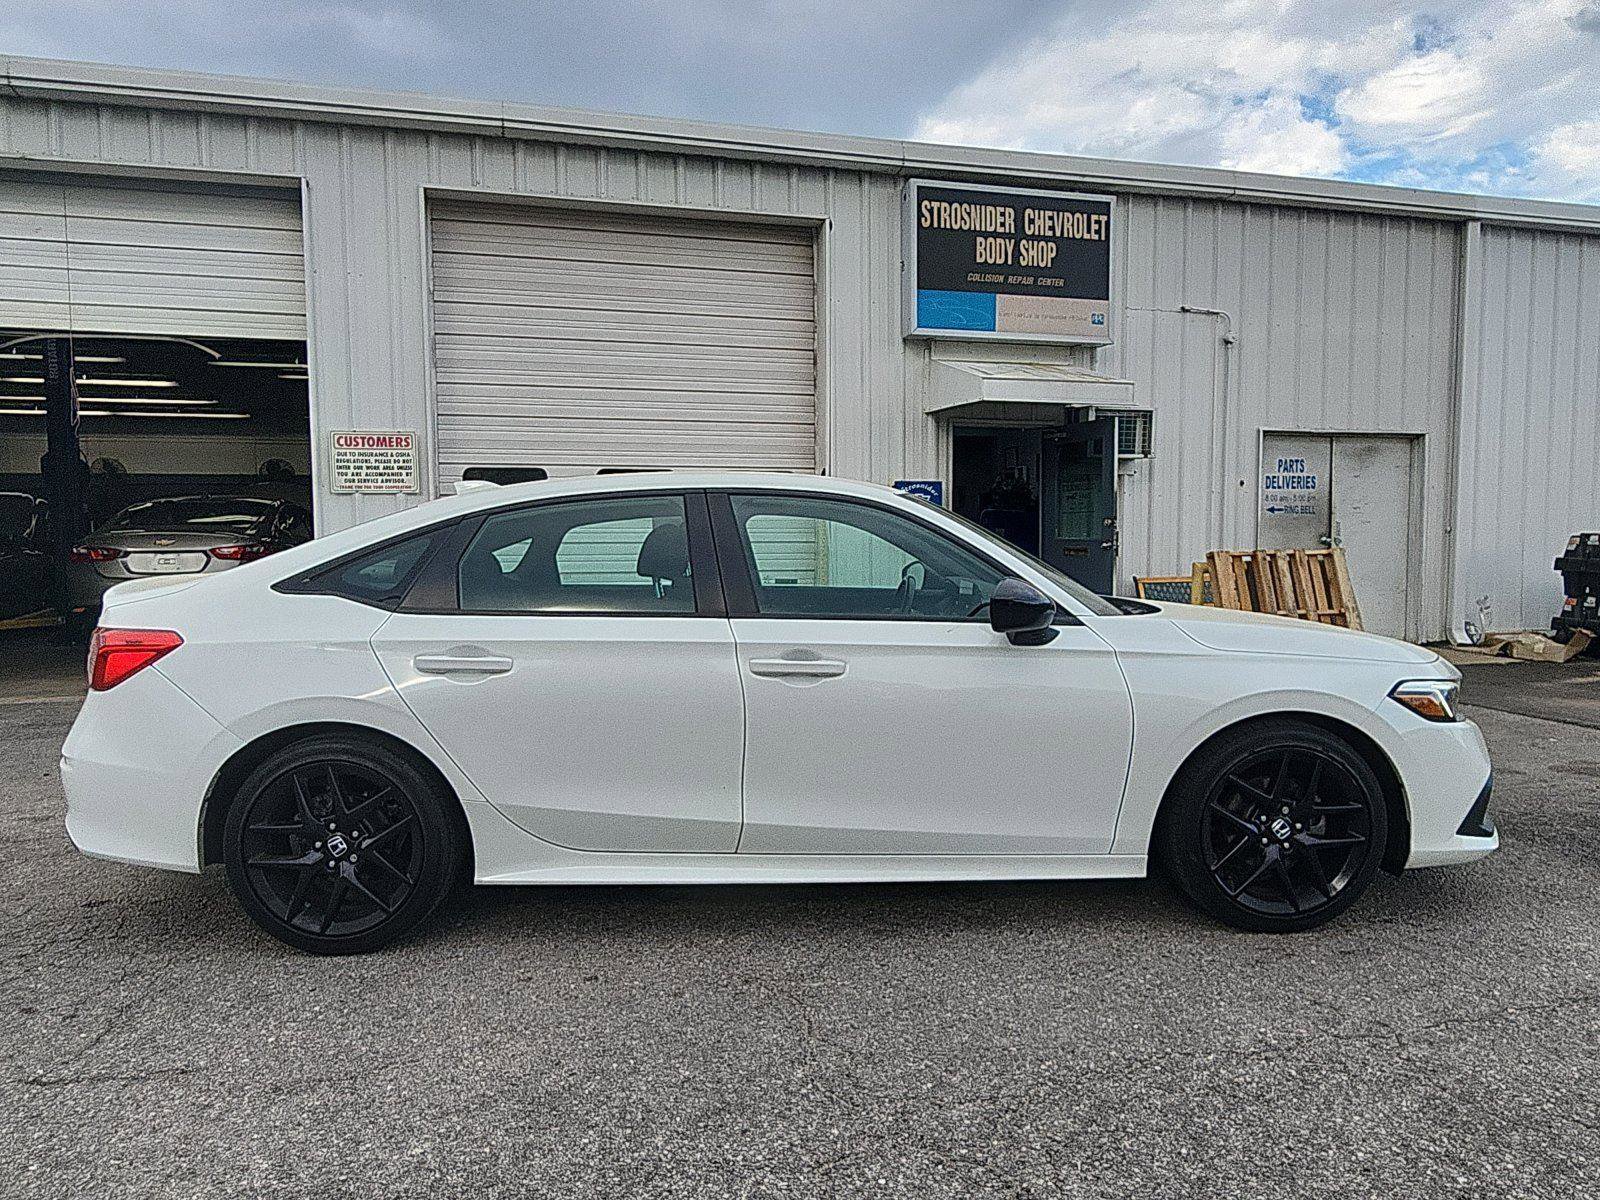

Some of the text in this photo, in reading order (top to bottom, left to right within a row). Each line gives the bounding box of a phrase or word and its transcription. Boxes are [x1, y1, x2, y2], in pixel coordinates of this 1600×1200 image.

[921, 200, 1108, 241] STROSNIDER CHEVROLET
[976, 236, 1057, 268] BODY SHOP
[967, 272, 1065, 287] COLLISION REPAIR CENTER
[336, 436, 411, 448] CUSTOMERS
[1277, 459, 1305, 473] PARTS
[1265, 475, 1316, 489] DELIVERIES
[1284, 505, 1316, 515] RING BELL
